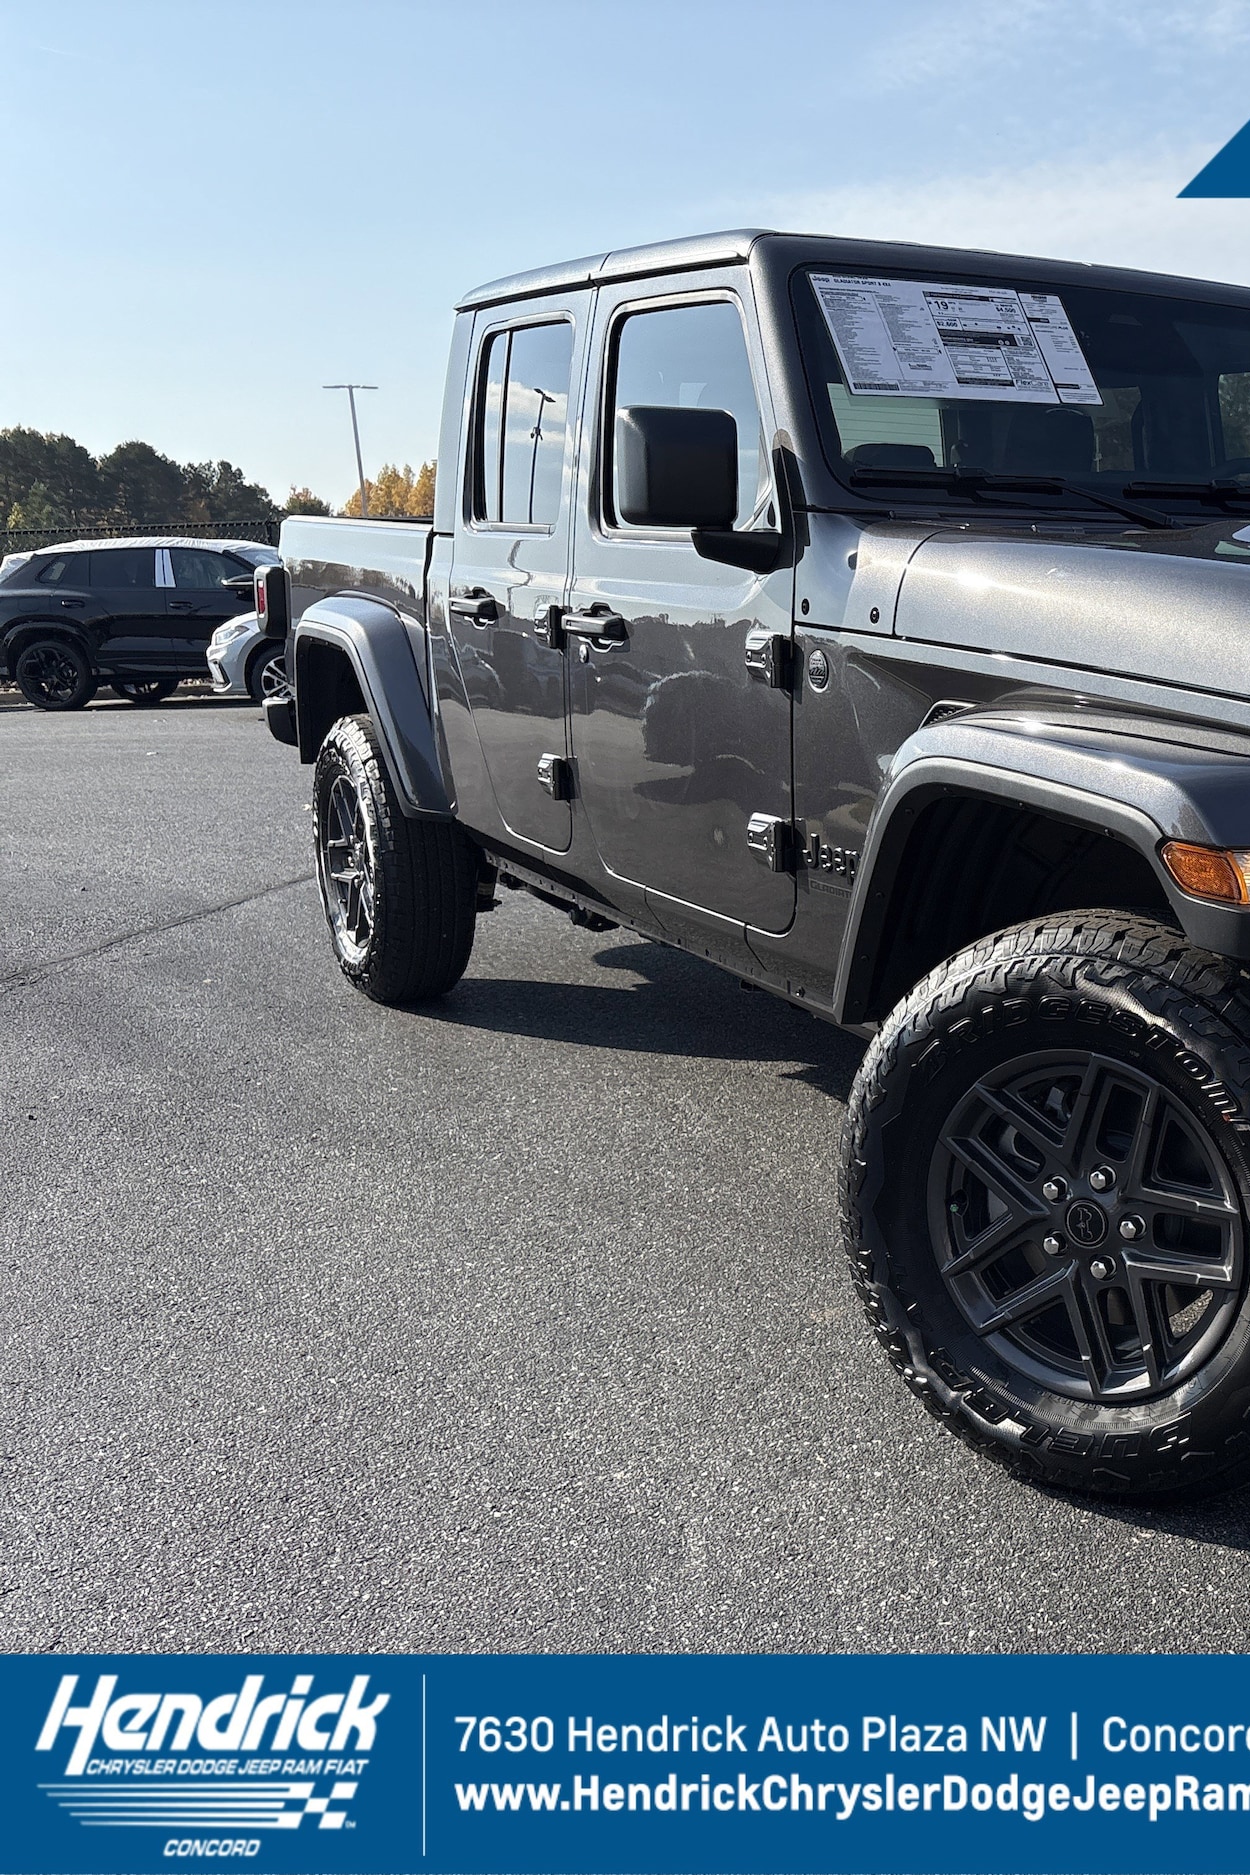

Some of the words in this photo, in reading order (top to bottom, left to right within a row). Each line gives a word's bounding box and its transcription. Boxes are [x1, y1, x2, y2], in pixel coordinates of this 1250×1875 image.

[934, 300, 949, 310] 19
[801, 832, 861, 886] Jeep
[810, 879, 852, 899] GLADIAT
